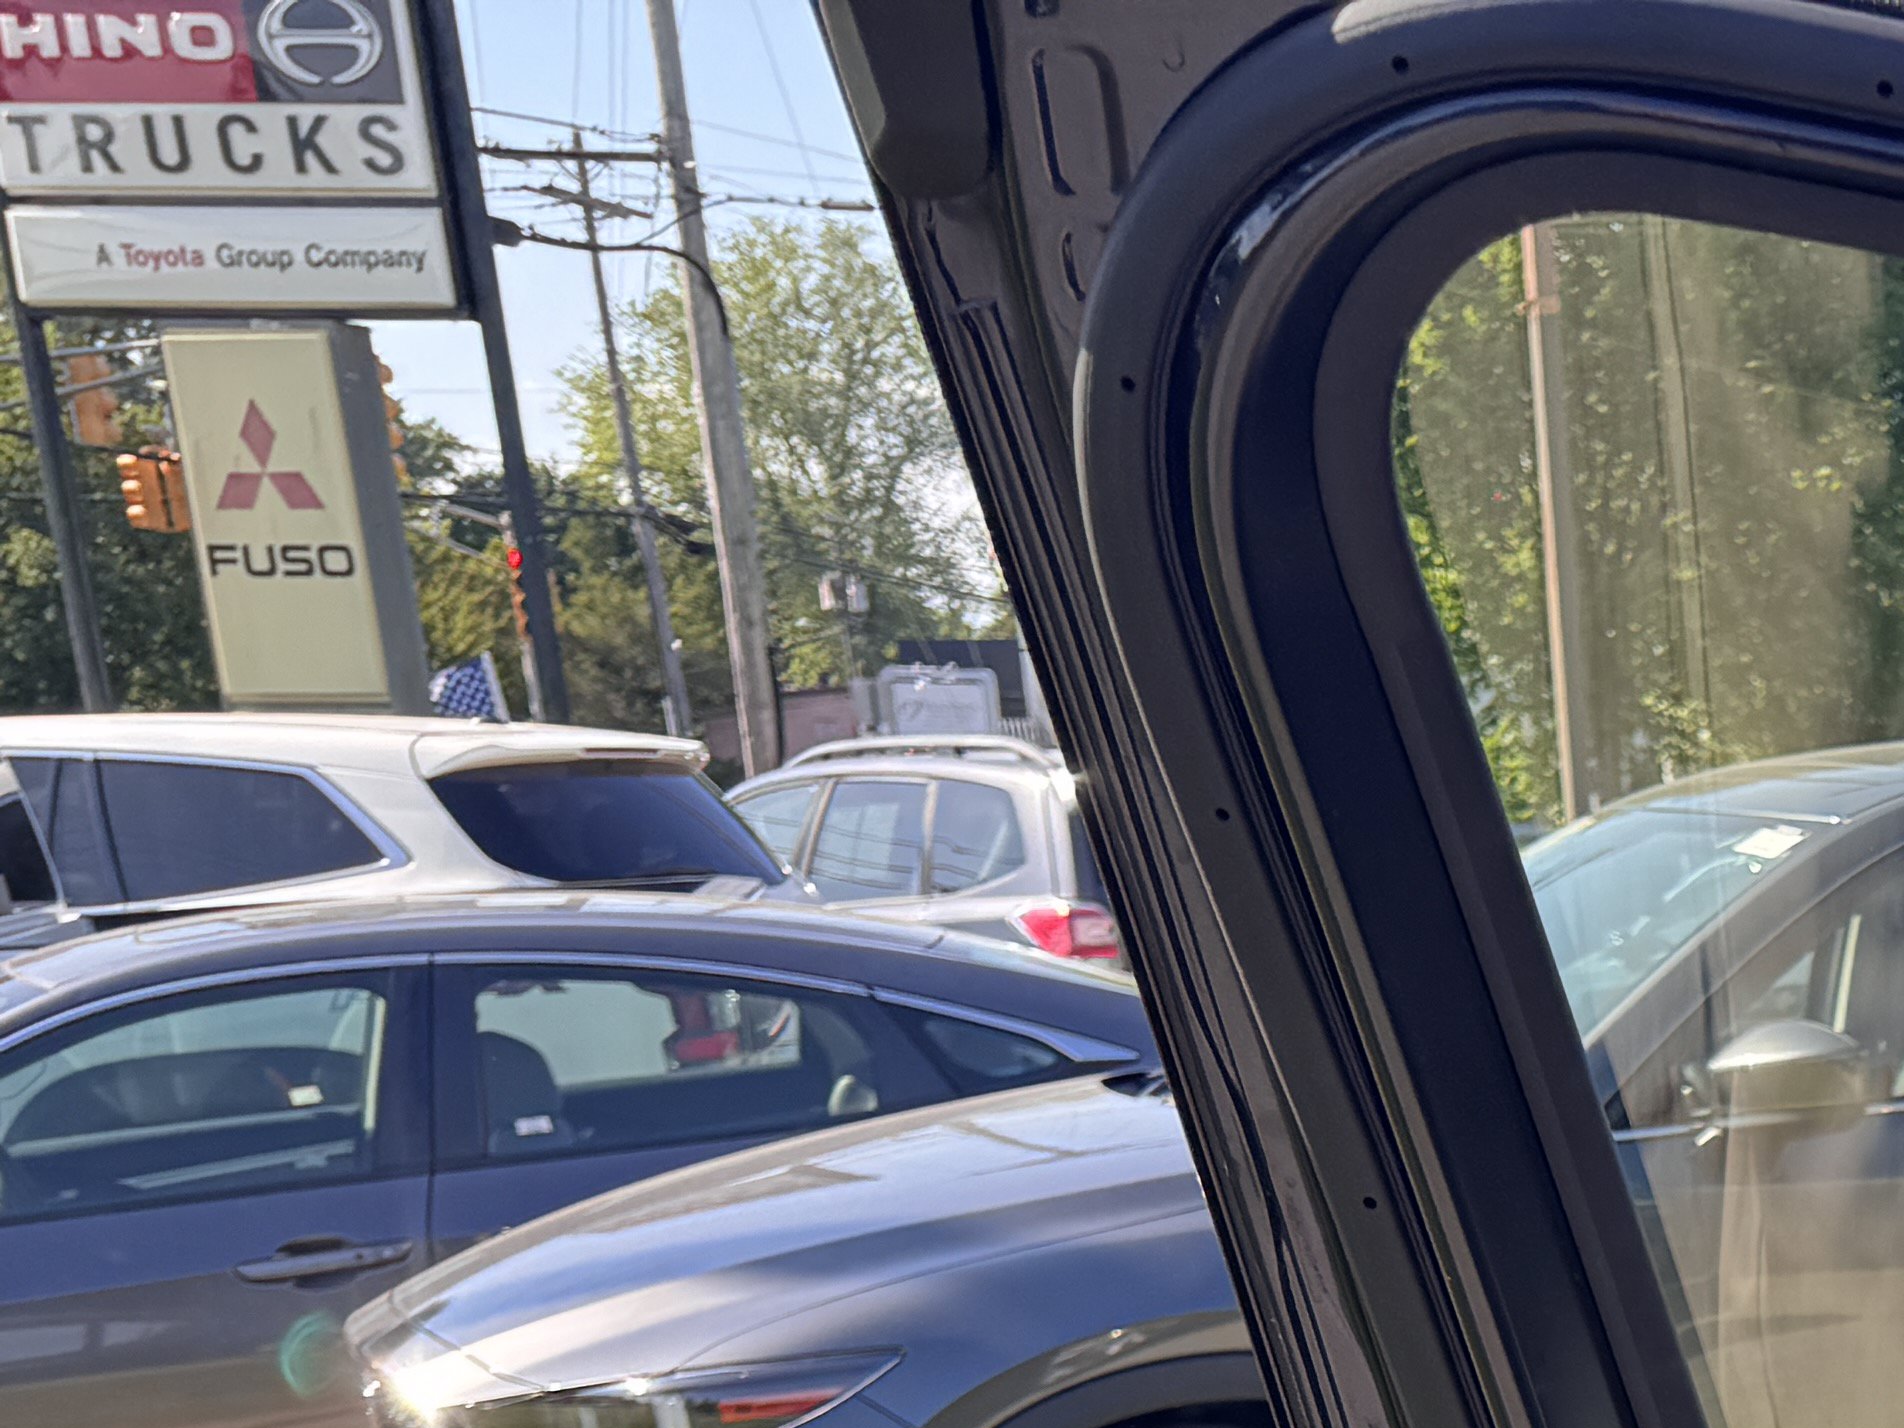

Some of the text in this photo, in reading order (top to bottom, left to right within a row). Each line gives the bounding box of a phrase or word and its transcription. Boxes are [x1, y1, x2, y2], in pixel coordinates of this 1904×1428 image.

[0, 12, 237, 61] HINO
[6, 114, 405, 174] TRUCKS
[97, 242, 427, 274] A Toyota Group Company
[206, 544, 355, 577] FUSO
